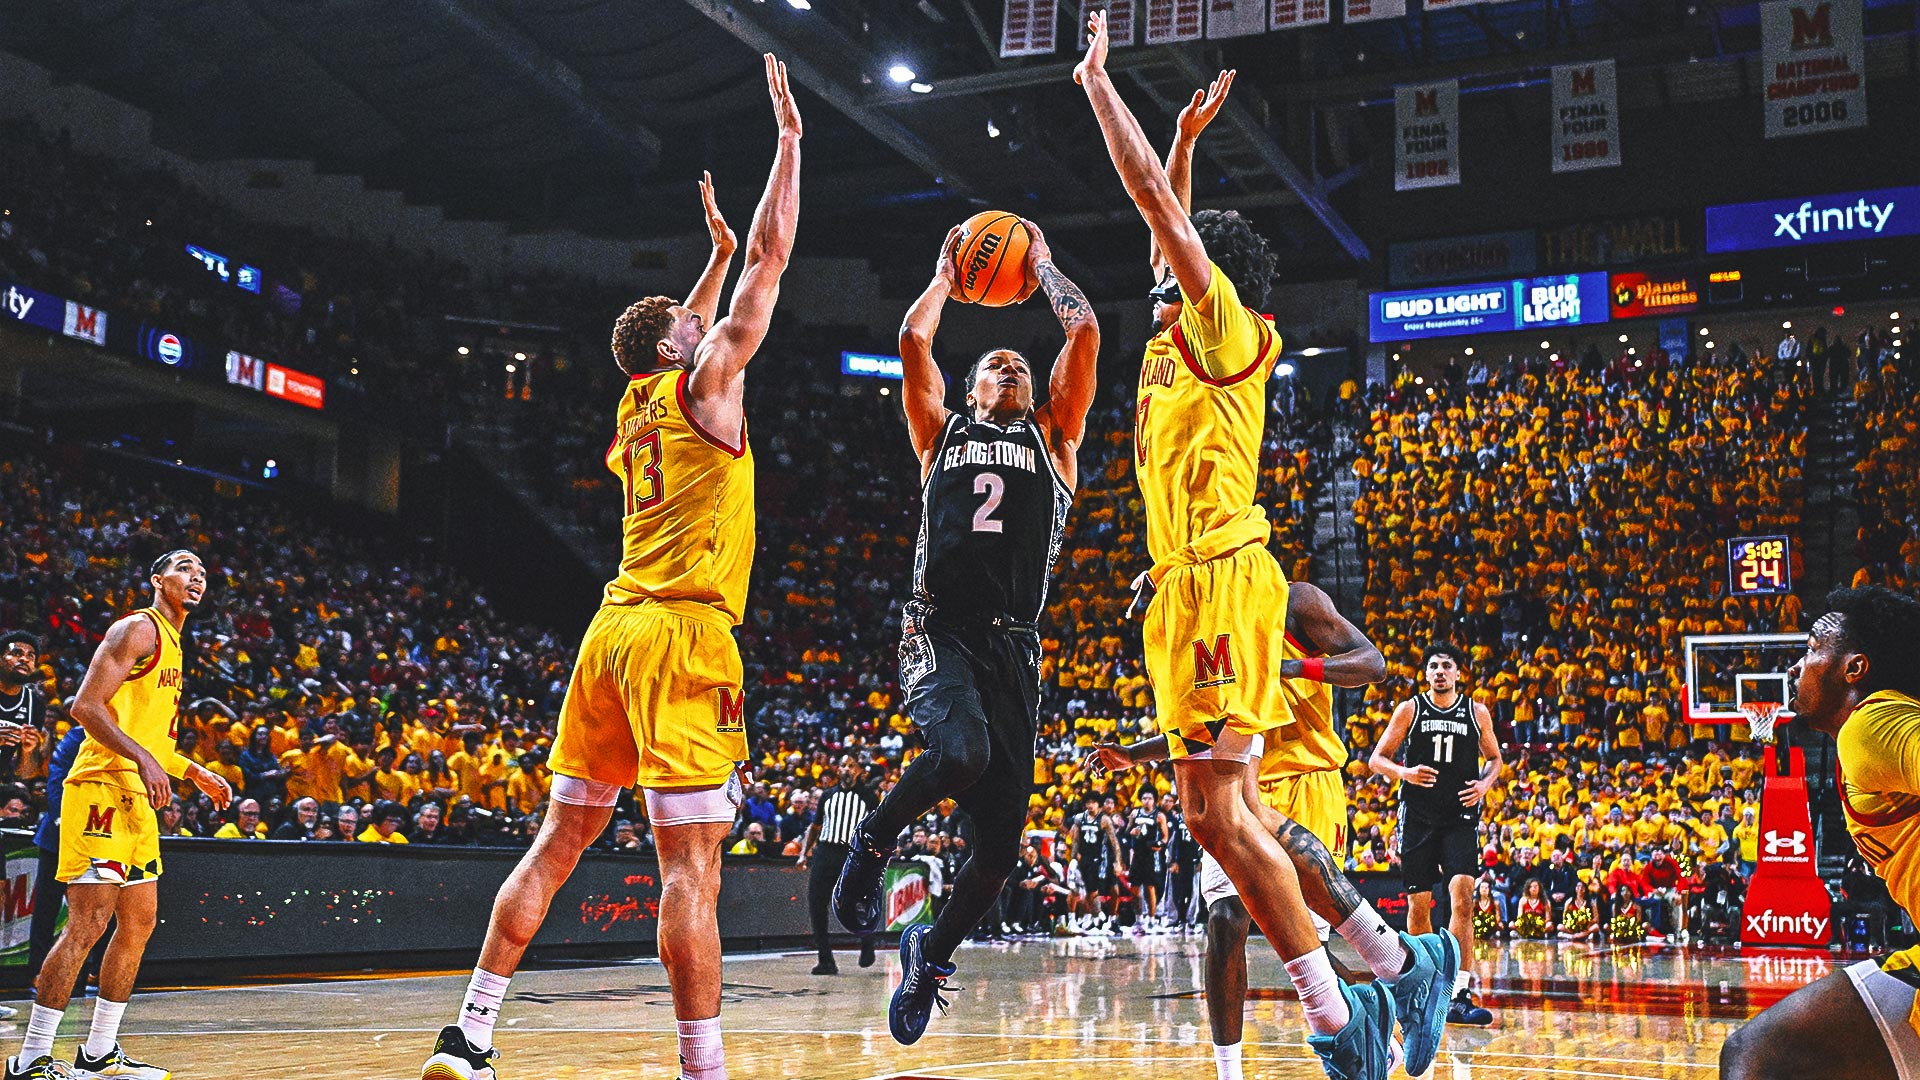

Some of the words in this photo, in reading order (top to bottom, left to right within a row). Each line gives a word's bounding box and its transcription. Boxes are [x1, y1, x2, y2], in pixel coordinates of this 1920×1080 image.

[1773, 197, 1895, 240] xfinity
[964, 232, 1003, 290] Wilson
[1532, 284, 1578, 305] BUD
[1637, 279, 1687, 299] planet
[76, 303, 97, 337] M
[1385, 299, 1434, 319] BUD
[1435, 292, 1502, 315] LIGHT
[1523, 299, 1581, 323] LIGHT
[631, 385, 649, 410] M
[622, 428, 665, 517] 13
[943, 440, 1037, 474] GEORGETOWN
[972, 470, 1005, 534] 2
[1744, 541, 1783, 560] 5:02
[1741, 560, 1780, 589] 24
[1192, 634, 1236, 683] M
[717, 687, 745, 727] M
[1421, 719, 1468, 737] GEORGETOWN
[1432, 733, 1454, 763] 11
[84, 804, 117, 835] M
[1746, 909, 1829, 940] xfinity
